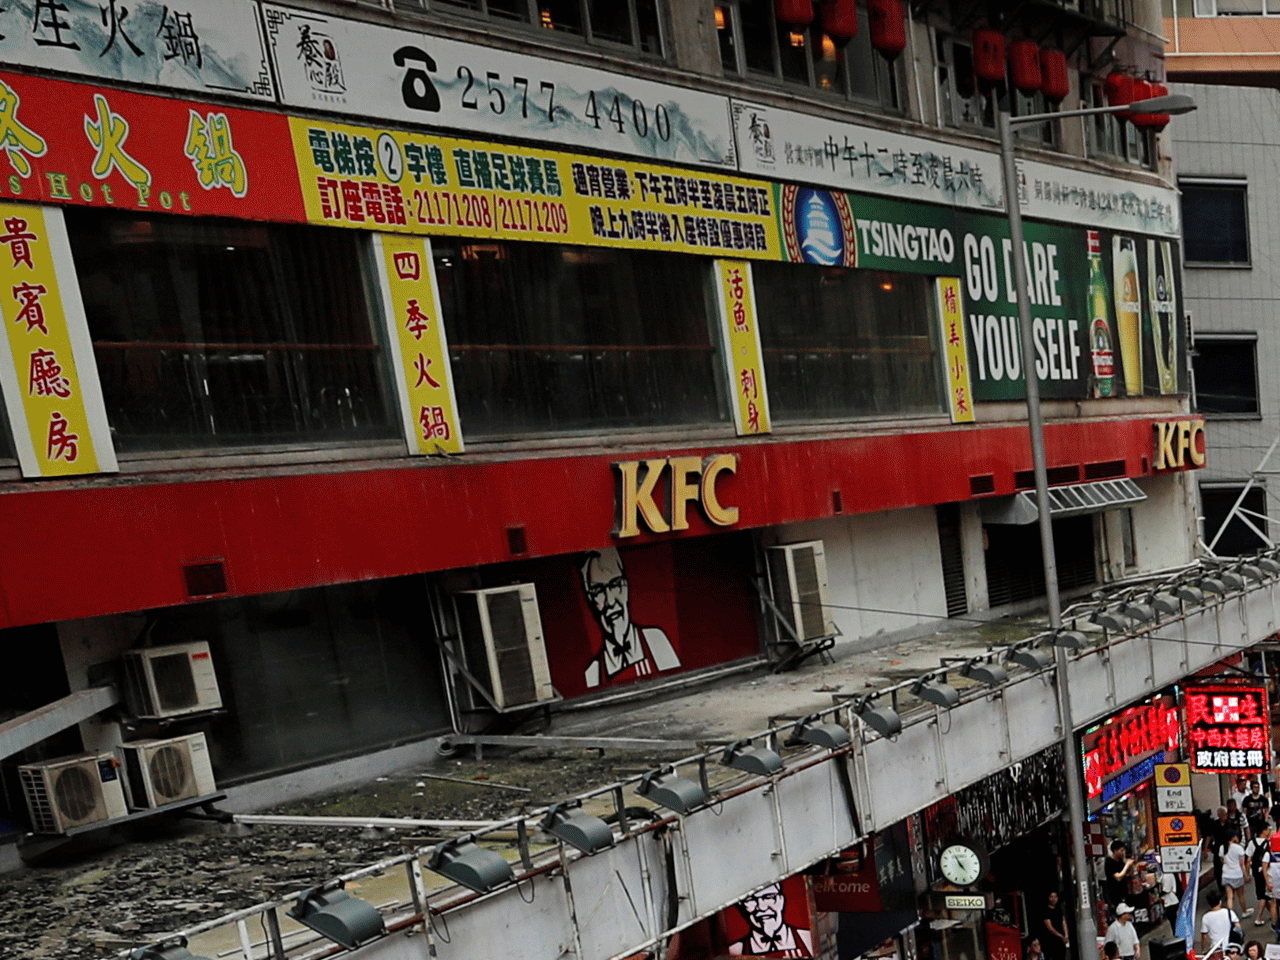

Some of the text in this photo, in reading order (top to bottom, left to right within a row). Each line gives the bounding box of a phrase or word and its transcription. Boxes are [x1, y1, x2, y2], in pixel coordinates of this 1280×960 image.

[0, 0, 203, 69] 生火鍋
[457, 65, 671, 143] 2577 4400
[47, 172, 114, 205] Hot
[137, 182, 192, 211] Pot
[856, 218, 955, 263] TSINGTAO
[963, 233, 998, 303] GO
[393, 249, 450, 442] 四季火鍋
[970, 314, 1080, 381] YOUSELF
[1155, 420, 1205, 469] KFC
[612, 453, 739, 538] KFC
[1167, 789, 1182, 797] End
[808, 880, 870, 894] ellcome
[947, 898, 983, 908] SEIKO
